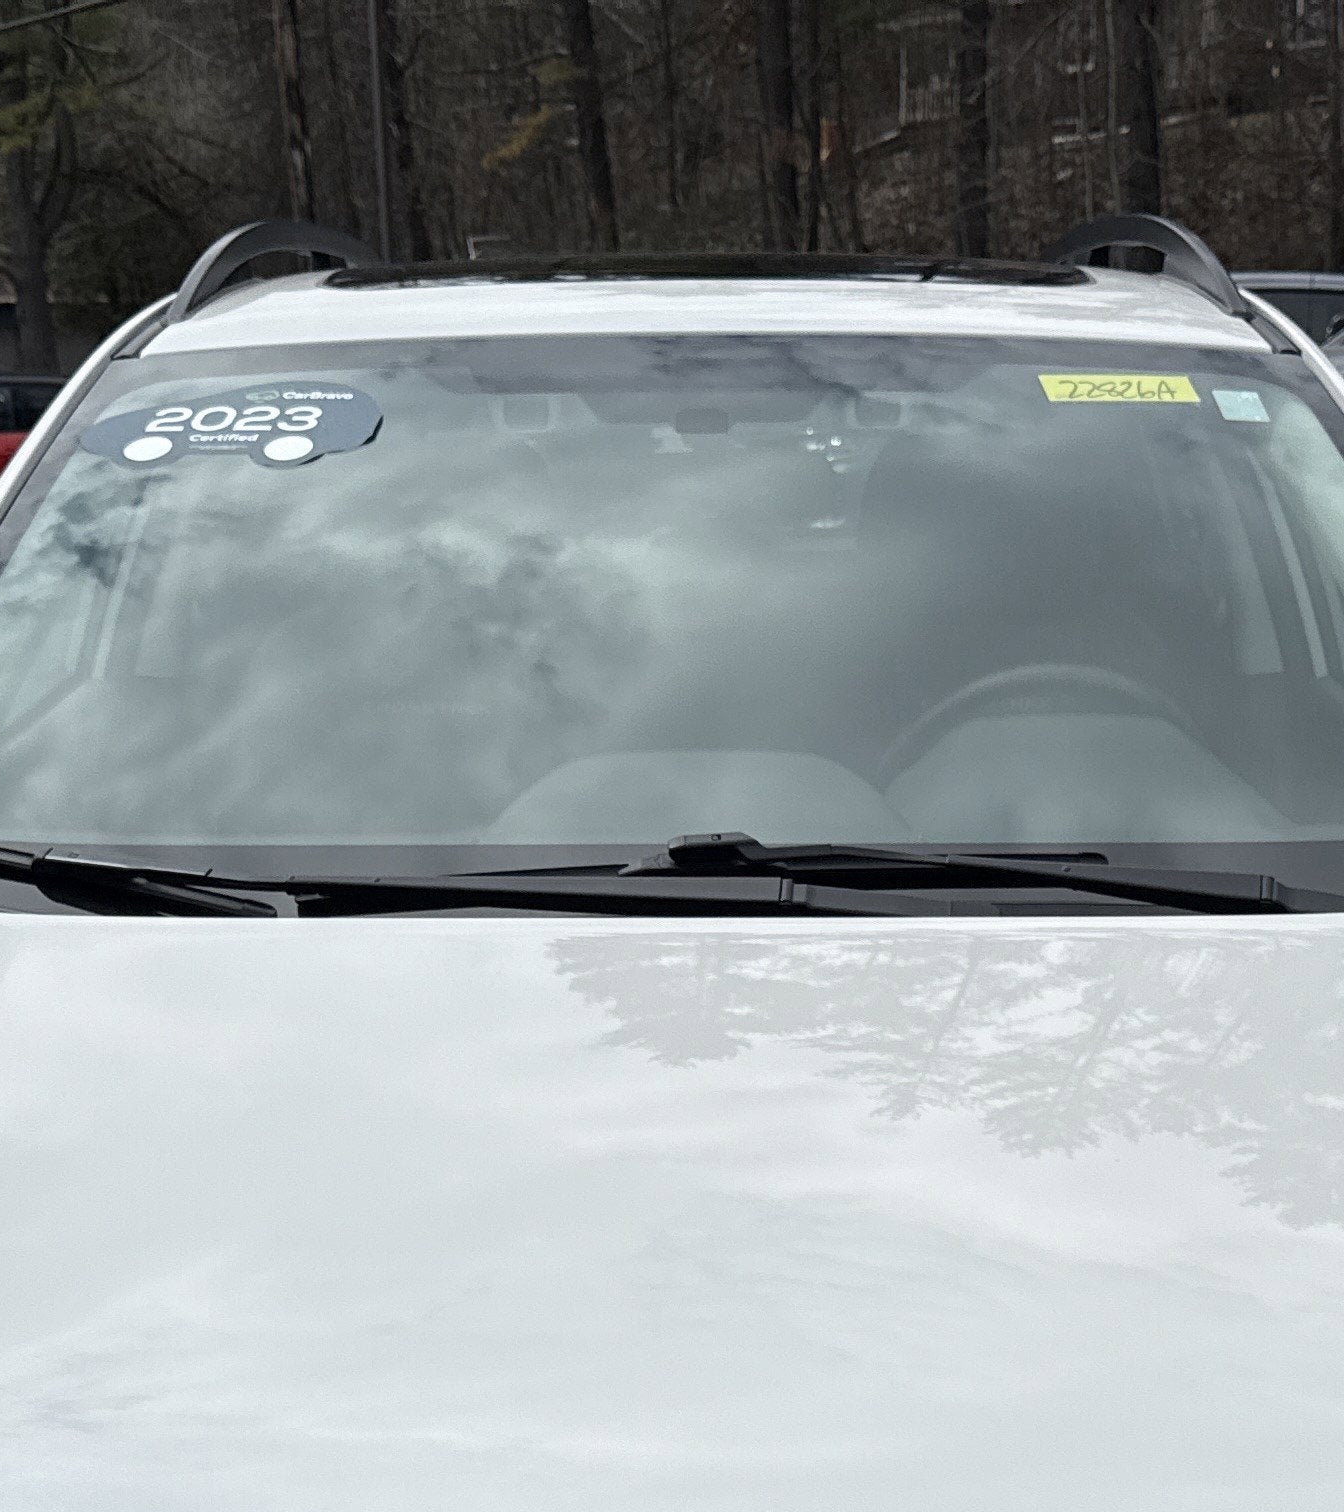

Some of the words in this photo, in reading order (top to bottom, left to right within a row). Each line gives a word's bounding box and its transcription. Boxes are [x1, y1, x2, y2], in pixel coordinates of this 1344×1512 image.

[282, 390, 354, 400] CarBravo
[144, 405, 324, 433] 2023
[189, 433, 260, 443] Certified
